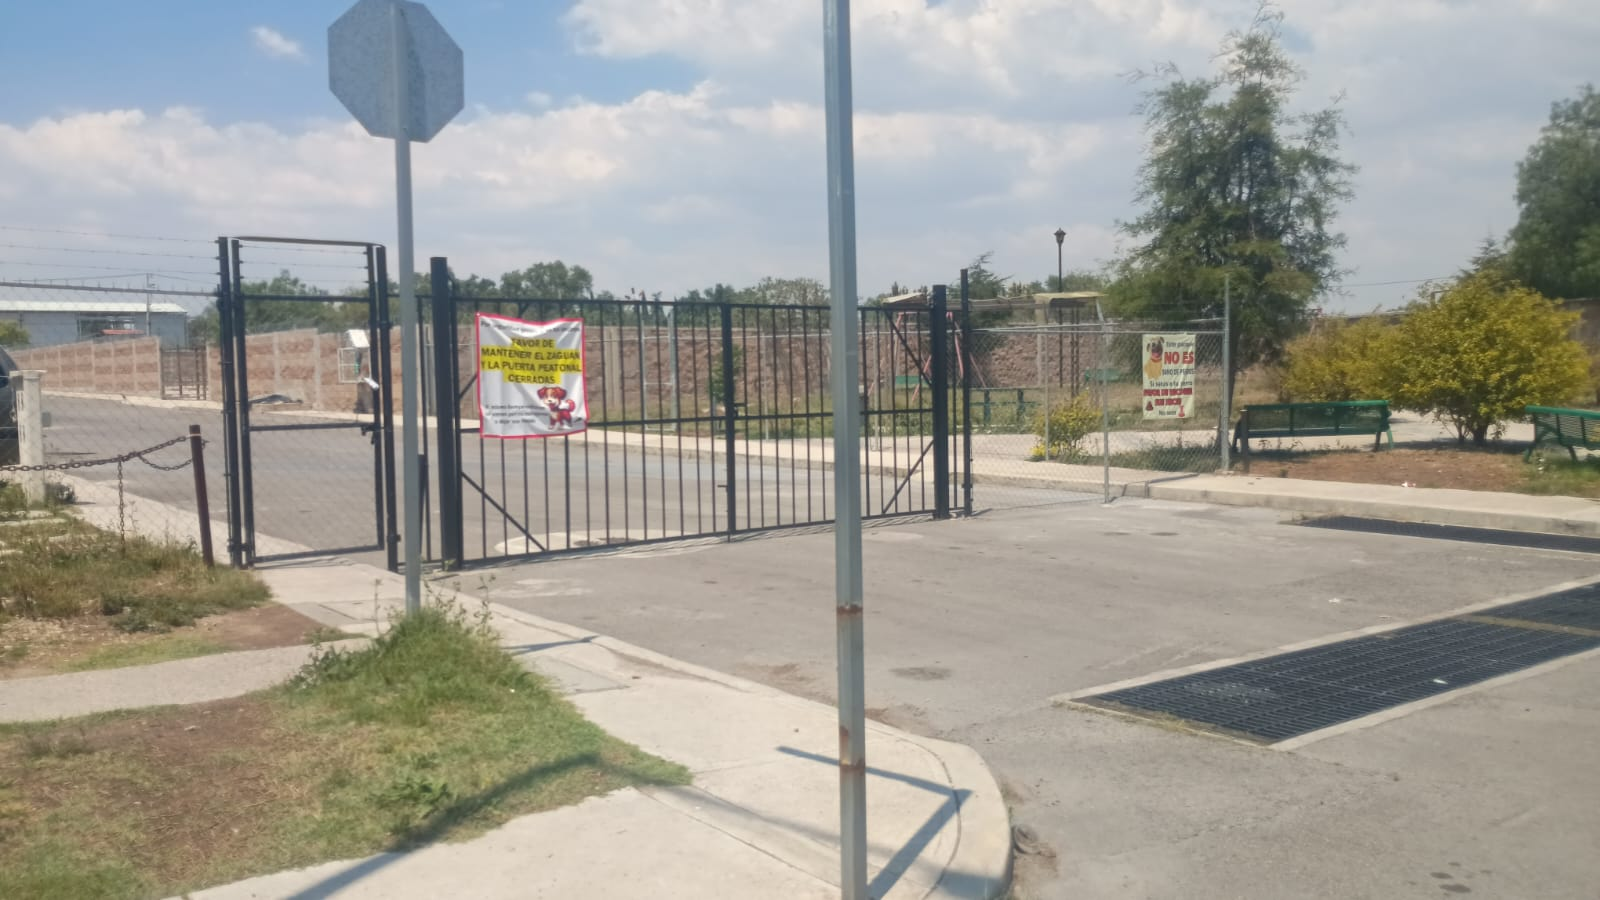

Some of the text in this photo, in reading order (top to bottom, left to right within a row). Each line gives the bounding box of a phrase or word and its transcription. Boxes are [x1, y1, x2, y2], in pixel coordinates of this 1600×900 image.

[542, 340, 554, 348] DE
[481, 347, 532, 359] MANTENER
[534, 351, 545, 361] EL
[1164, 352, 1194, 365] NO ES
[488, 360, 500, 370] LA
[502, 361, 536, 372] PUERTA
[538, 363, 582, 373] PEATONAL
[507, 374, 556, 385] CERRADAS
